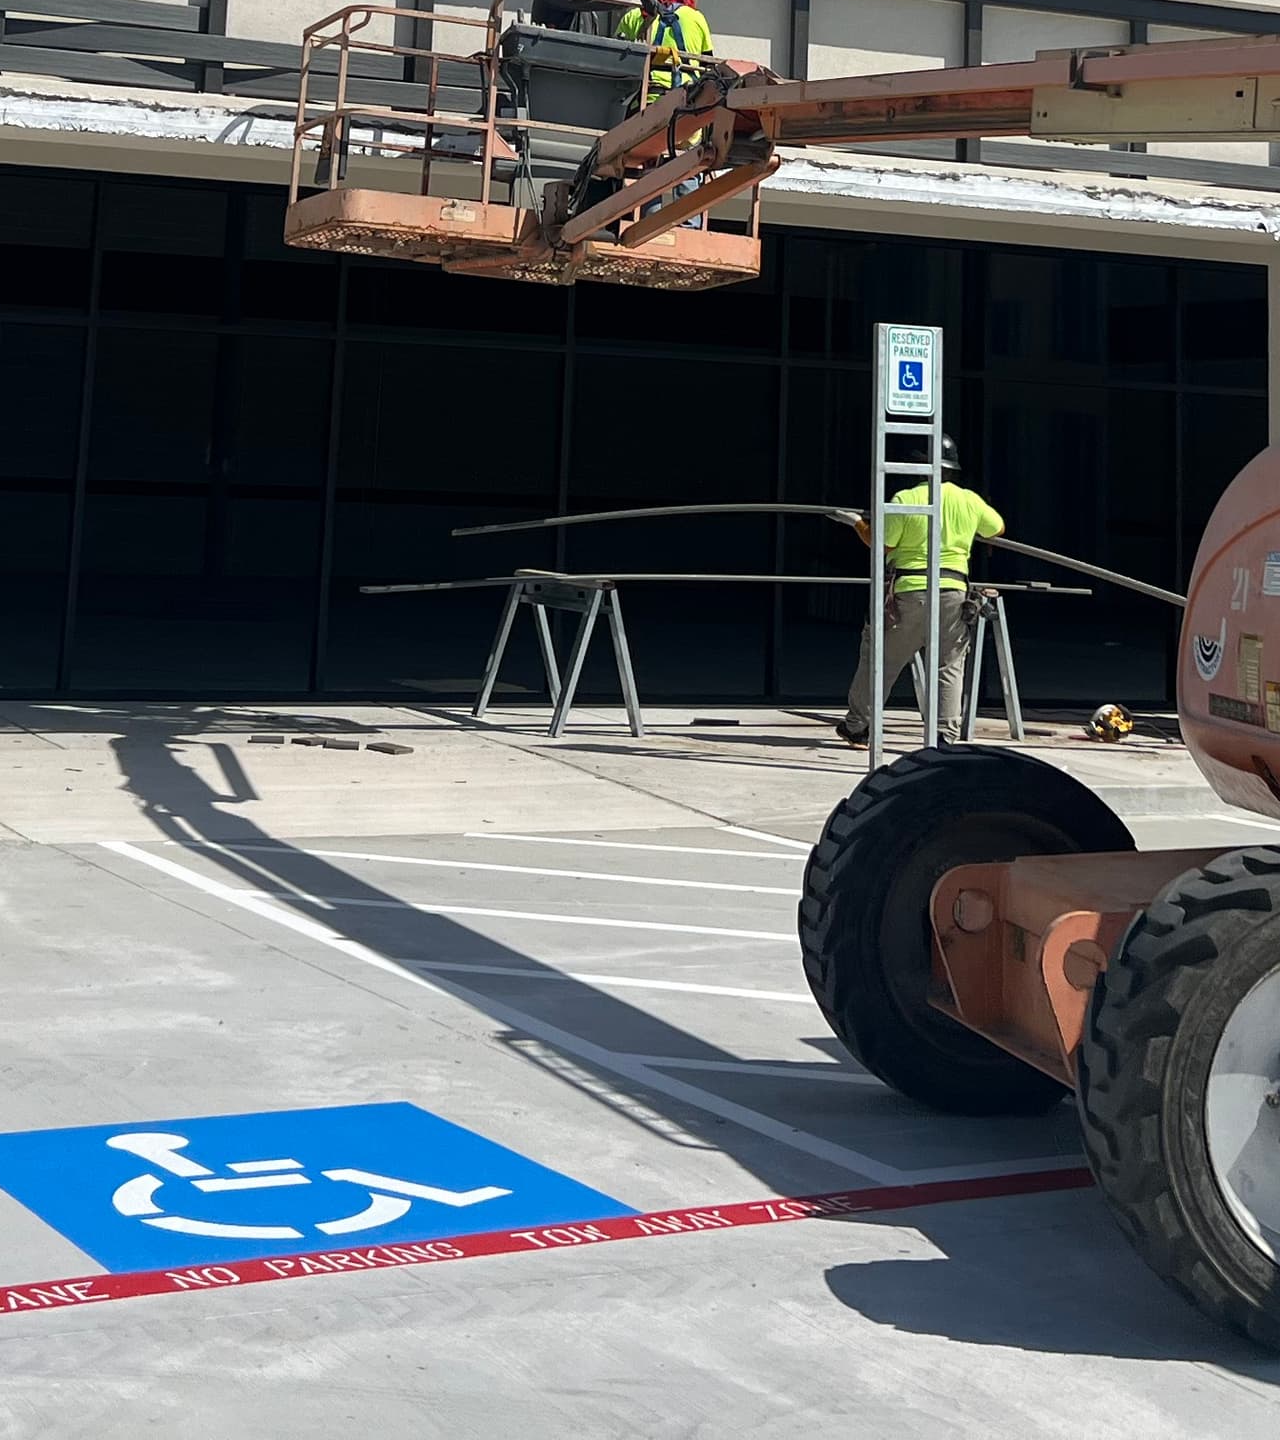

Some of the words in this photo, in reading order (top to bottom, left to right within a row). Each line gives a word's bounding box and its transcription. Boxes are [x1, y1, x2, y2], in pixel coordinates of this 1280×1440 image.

[891, 333, 930, 346] RESERVED
[893, 346, 928, 358] PARKING
[165, 1266, 241, 1290] NO
[264, 1241, 464, 1277] PARKING
[510, 1224, 611, 1249] TOW
[634, 1210, 734, 1236] AWAY
[749, 1195, 872, 1222] ZONE
